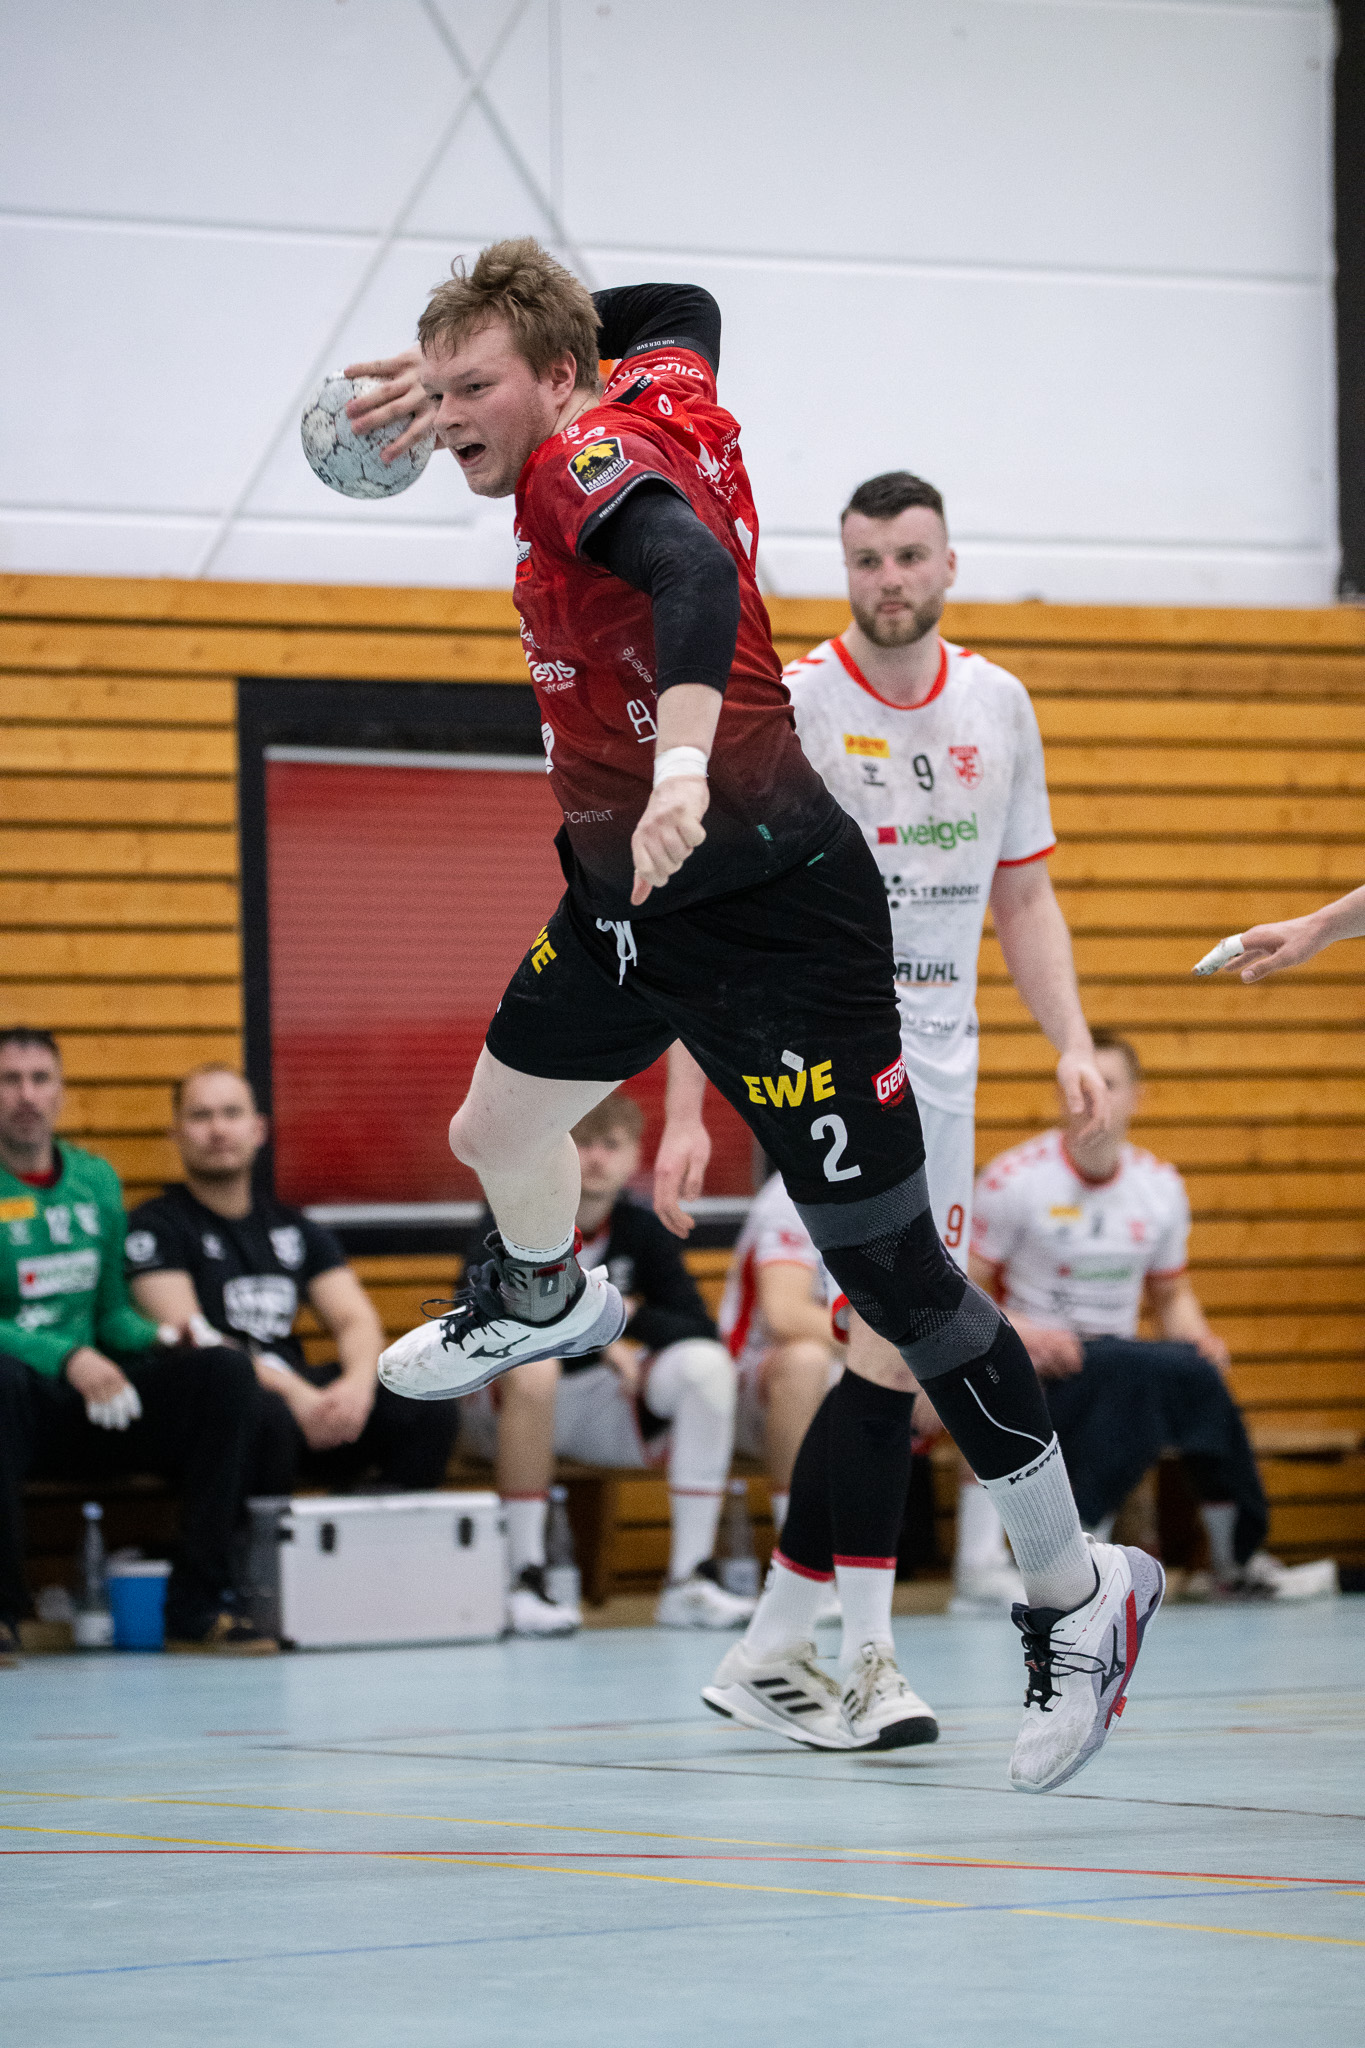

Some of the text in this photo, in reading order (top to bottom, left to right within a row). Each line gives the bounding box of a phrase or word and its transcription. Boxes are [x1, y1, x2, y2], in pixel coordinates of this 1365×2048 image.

[650, 340, 661, 348] DER
[912, 753, 935, 792] 9
[741, 1059, 837, 1108] EWE
[810, 1113, 862, 1183] 2
[944, 1203, 965, 1249] 9
